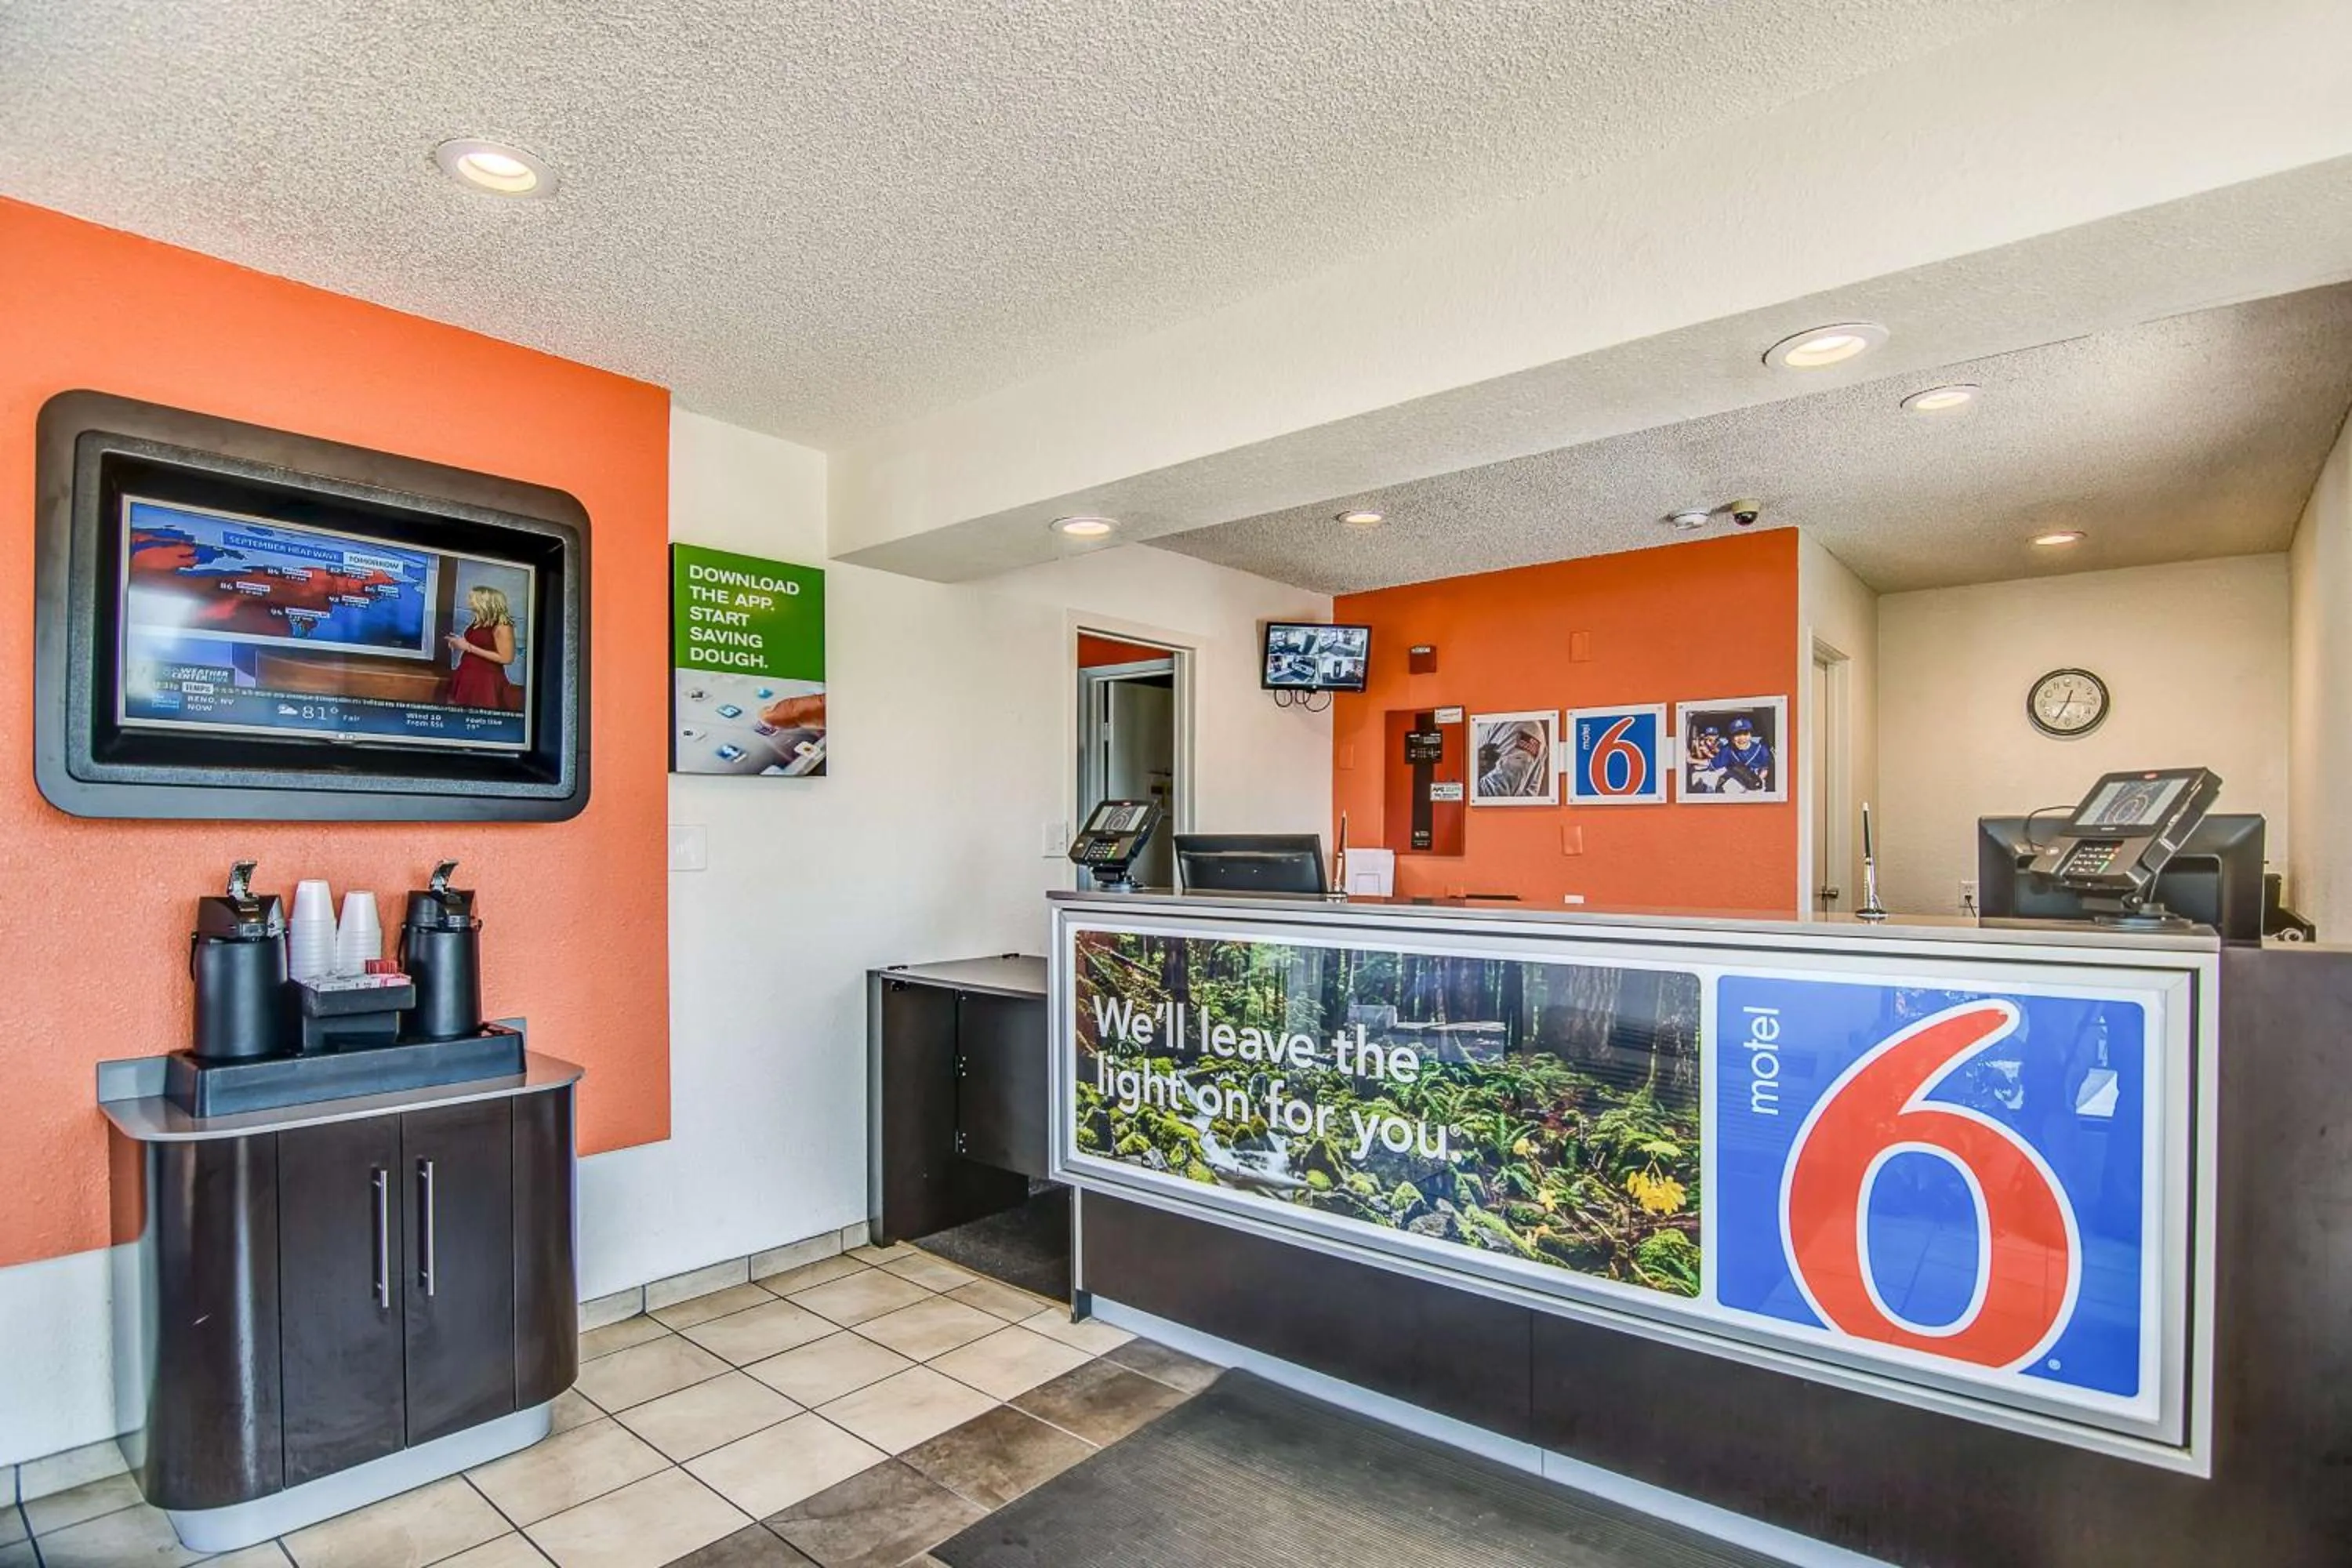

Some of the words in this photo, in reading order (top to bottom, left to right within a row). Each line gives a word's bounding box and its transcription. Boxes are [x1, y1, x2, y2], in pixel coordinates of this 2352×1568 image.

[349, 556, 399, 570] TOMORROW
[688, 564, 800, 596] DOWNLOAD
[689, 585, 729, 605] THE
[734, 593, 776, 612] APP.
[689, 606, 750, 627] START
[689, 626, 764, 648] SAVING
[689, 647, 769, 669] DOUGH.
[187, 704, 212, 713] NOW
[1589, 716, 1647, 795] 6
[1092, 995, 1185, 1051] We'll
[1200, 1005, 1316, 1069] leave
[1330, 1023, 1421, 1083] the
[1097, 1050, 1185, 1115] light
[1196, 1083, 1250, 1123] on
[1264, 1079, 1335, 1138] for
[1742, 1007, 1781, 1116] motel
[1778, 997, 2083, 1374] 6
